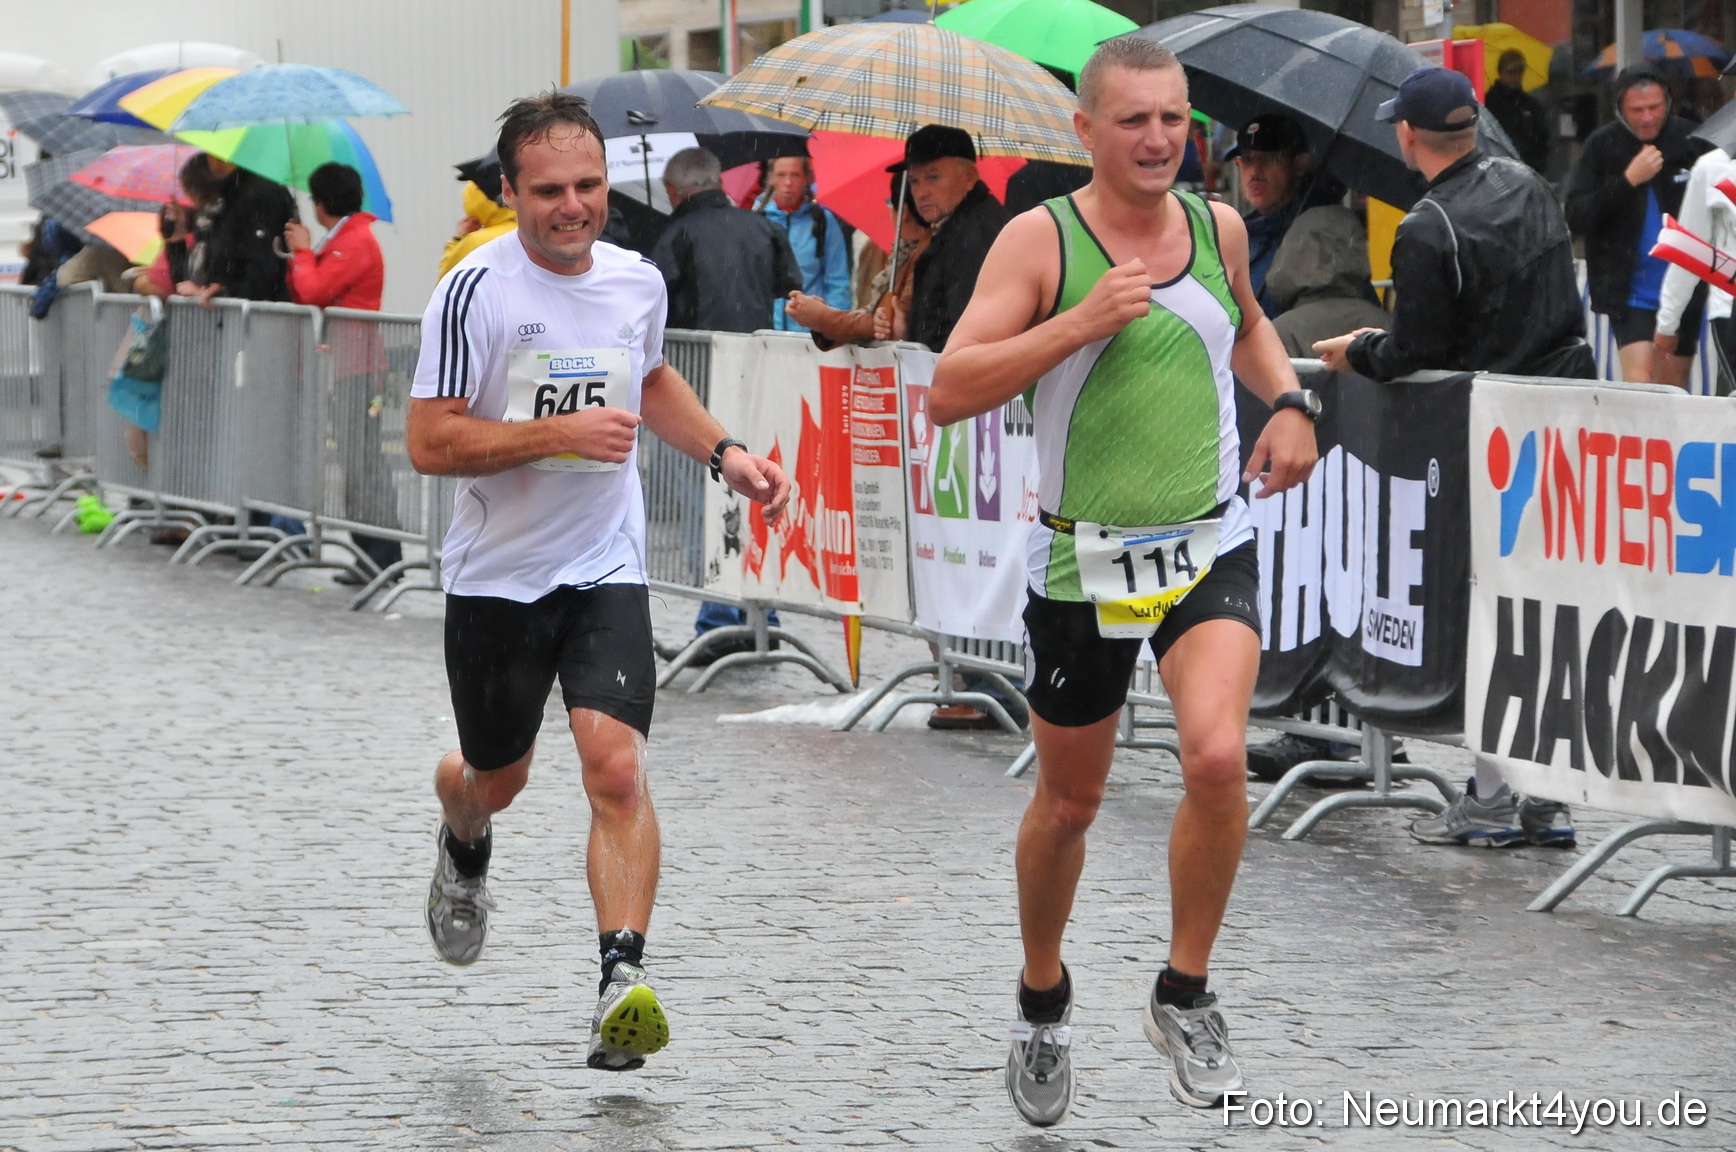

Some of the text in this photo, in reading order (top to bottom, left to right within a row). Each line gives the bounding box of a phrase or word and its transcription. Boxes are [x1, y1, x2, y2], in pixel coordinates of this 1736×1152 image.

[549, 356, 596, 371] BOCK
[534, 382, 606, 420] 645
[1540, 425, 1736, 577] INTERS
[1111, 538, 1198, 594] 114
[1367, 608, 1417, 651] SWEDEN
[1480, 595, 1736, 798] HACKN
